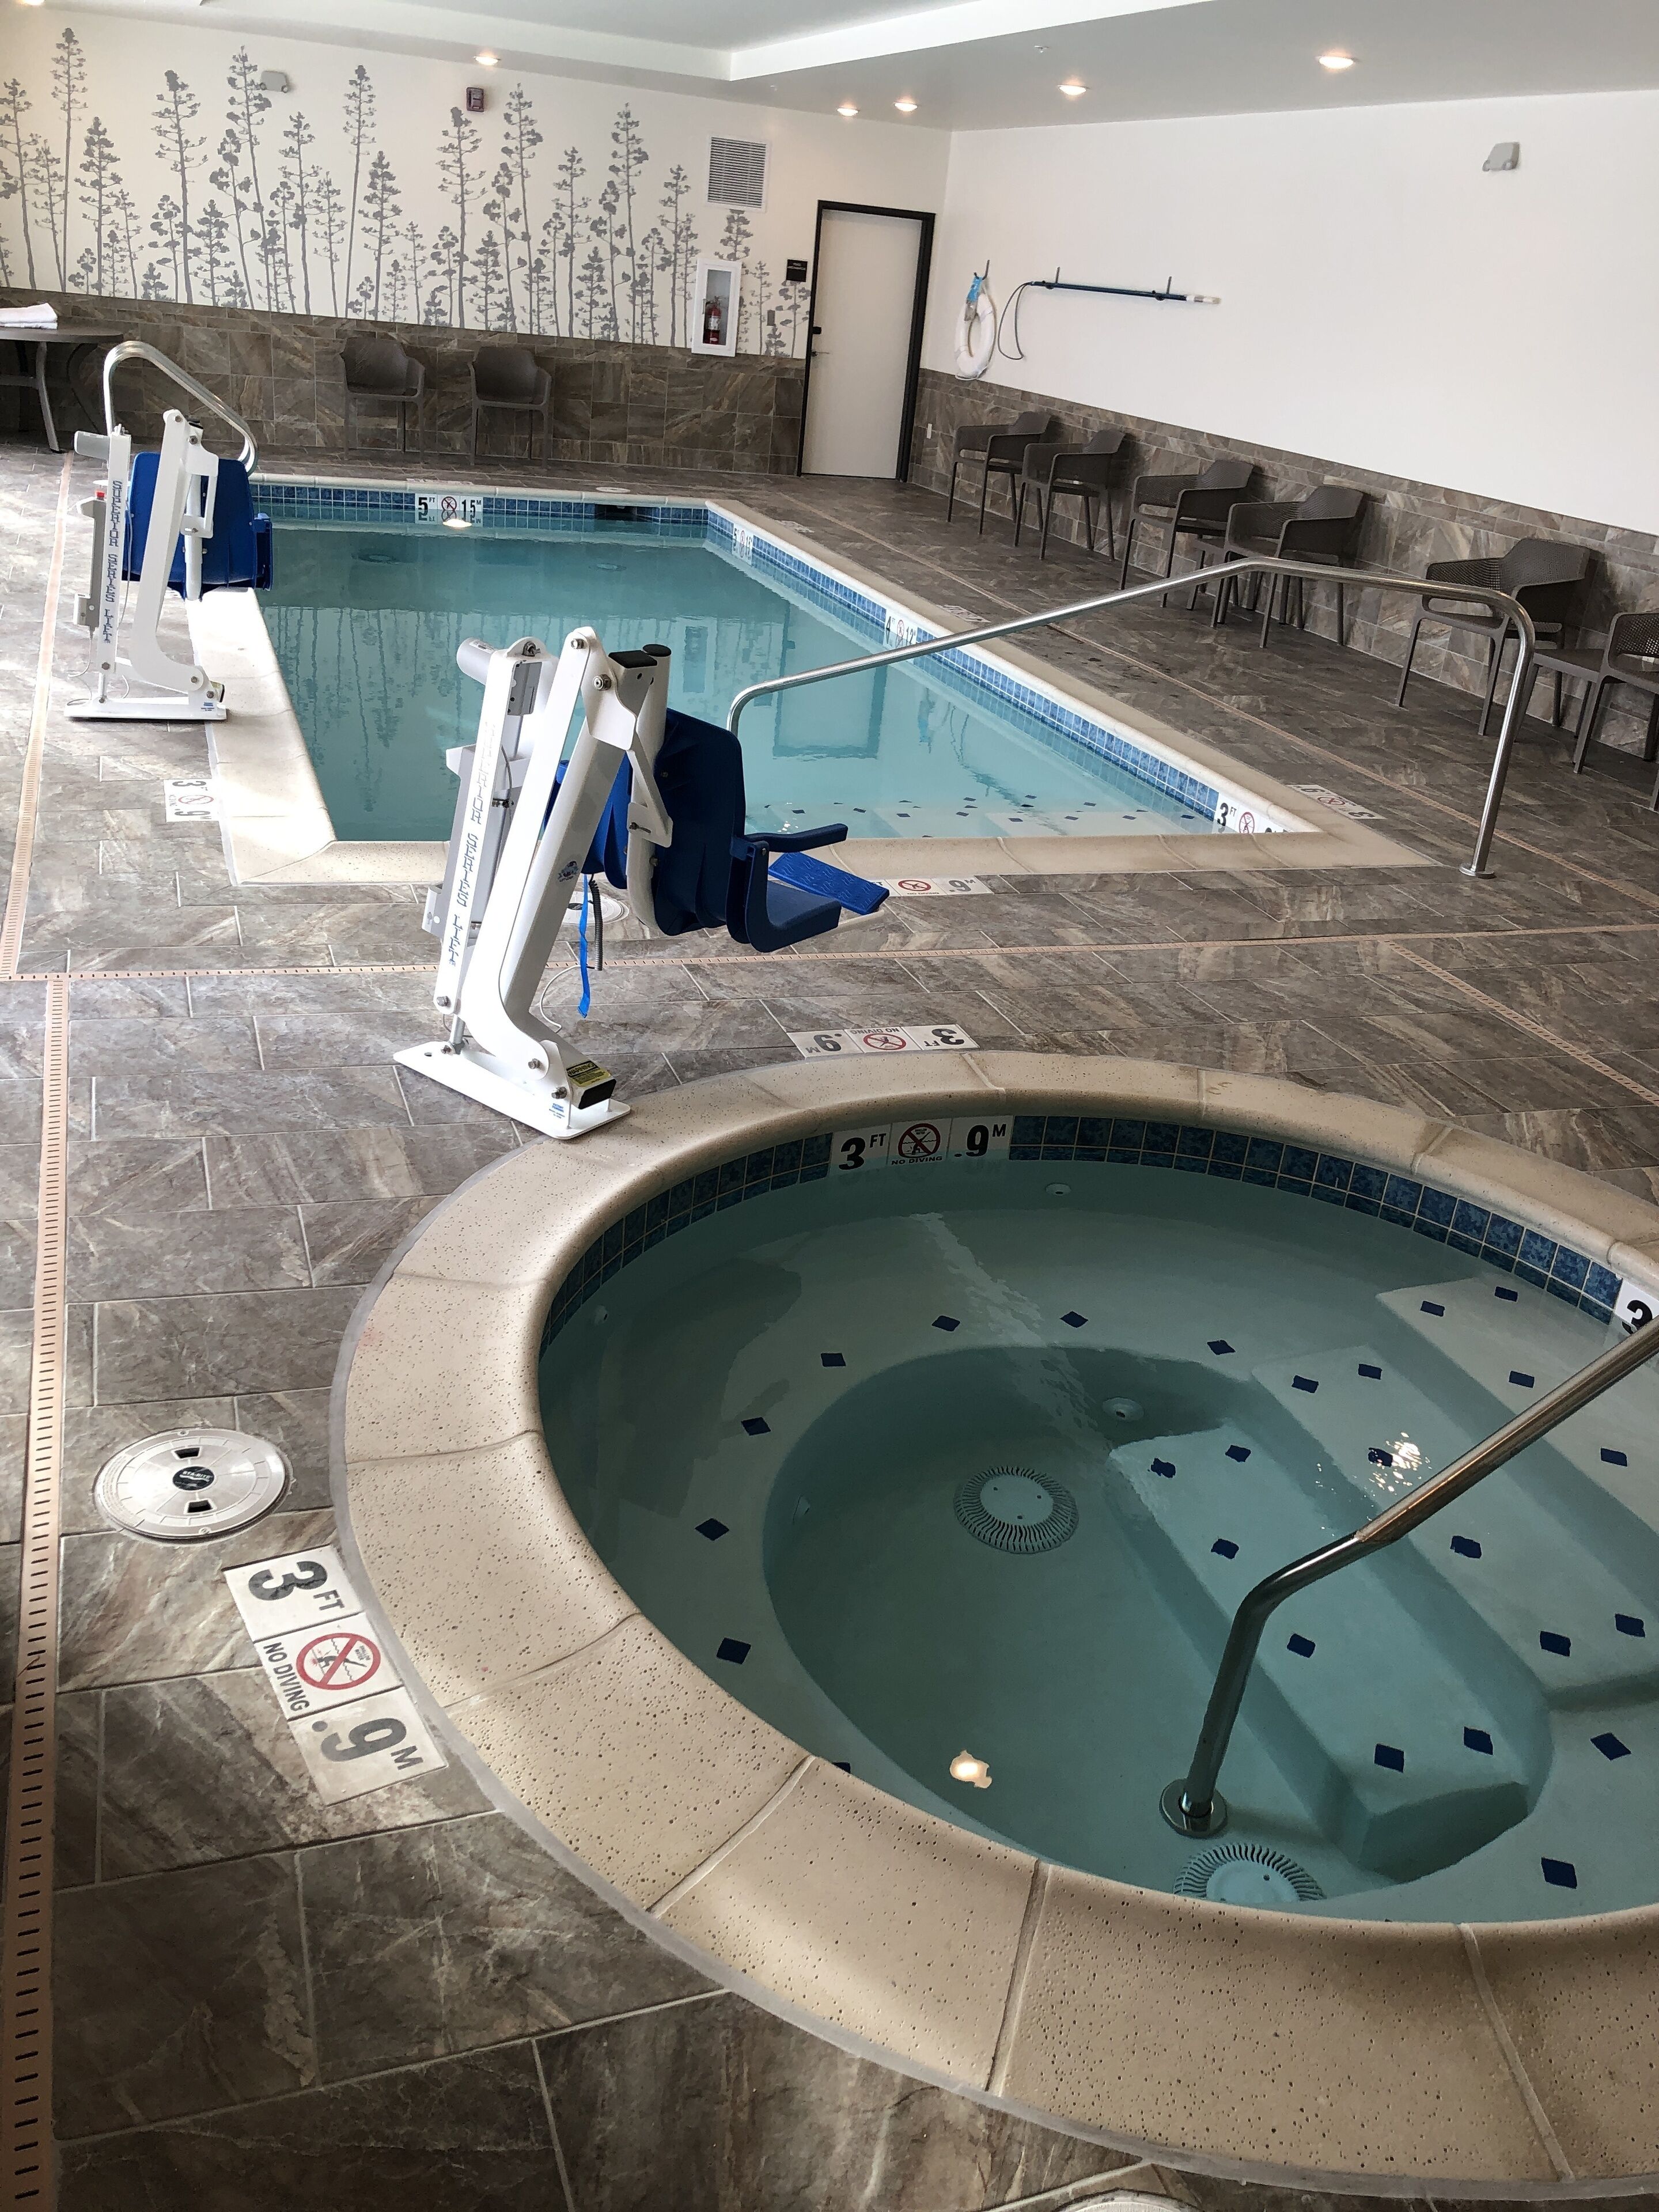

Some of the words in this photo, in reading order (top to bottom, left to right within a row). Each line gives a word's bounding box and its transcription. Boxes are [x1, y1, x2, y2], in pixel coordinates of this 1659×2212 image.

[109, 480, 123, 547] SUPERIOR
[105, 554, 119, 603] SERIES
[103, 609, 114, 641] LIFT
[1217, 802, 1229, 827] 3
[457, 832, 479, 908] SERIES
[449, 914, 464, 963] LIFT
[931, 1028, 965, 1046] 3
[992, 1123, 1007, 1138] M
[838, 1137, 866, 1171] 3
[869, 1132, 887, 1149] FT
[248, 1560, 328, 1601] 3
[313, 1589, 346, 1611] FT
[263, 1642, 287, 1663] NO
[273, 1663, 311, 1712] DIVING
[391, 1745, 424, 1771] M
